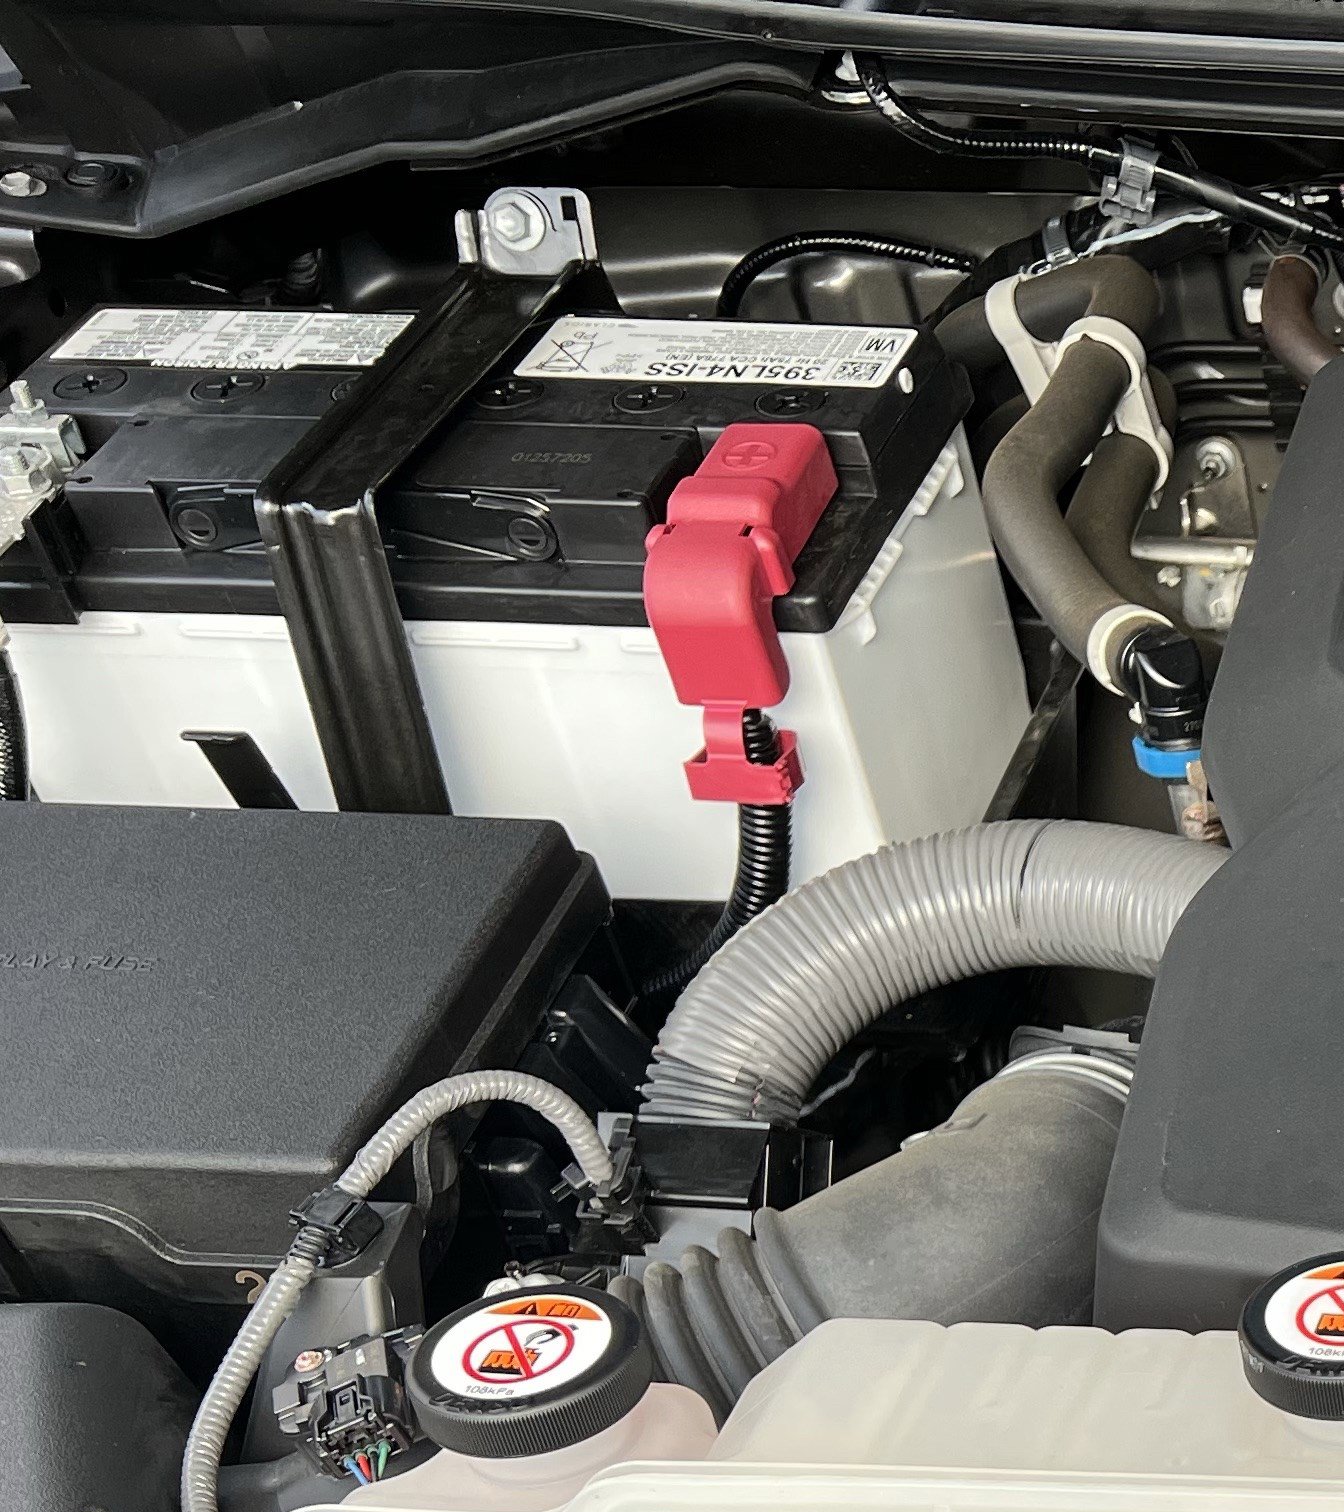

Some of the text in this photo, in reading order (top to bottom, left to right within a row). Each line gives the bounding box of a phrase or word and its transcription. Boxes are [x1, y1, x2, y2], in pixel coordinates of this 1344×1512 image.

[864, 337, 897, 352] VM
[647, 361, 822, 381] 395LN4-ISS
[0, 953, 60, 969] LAY
[464, 1384, 515, 1395] 108kPa
